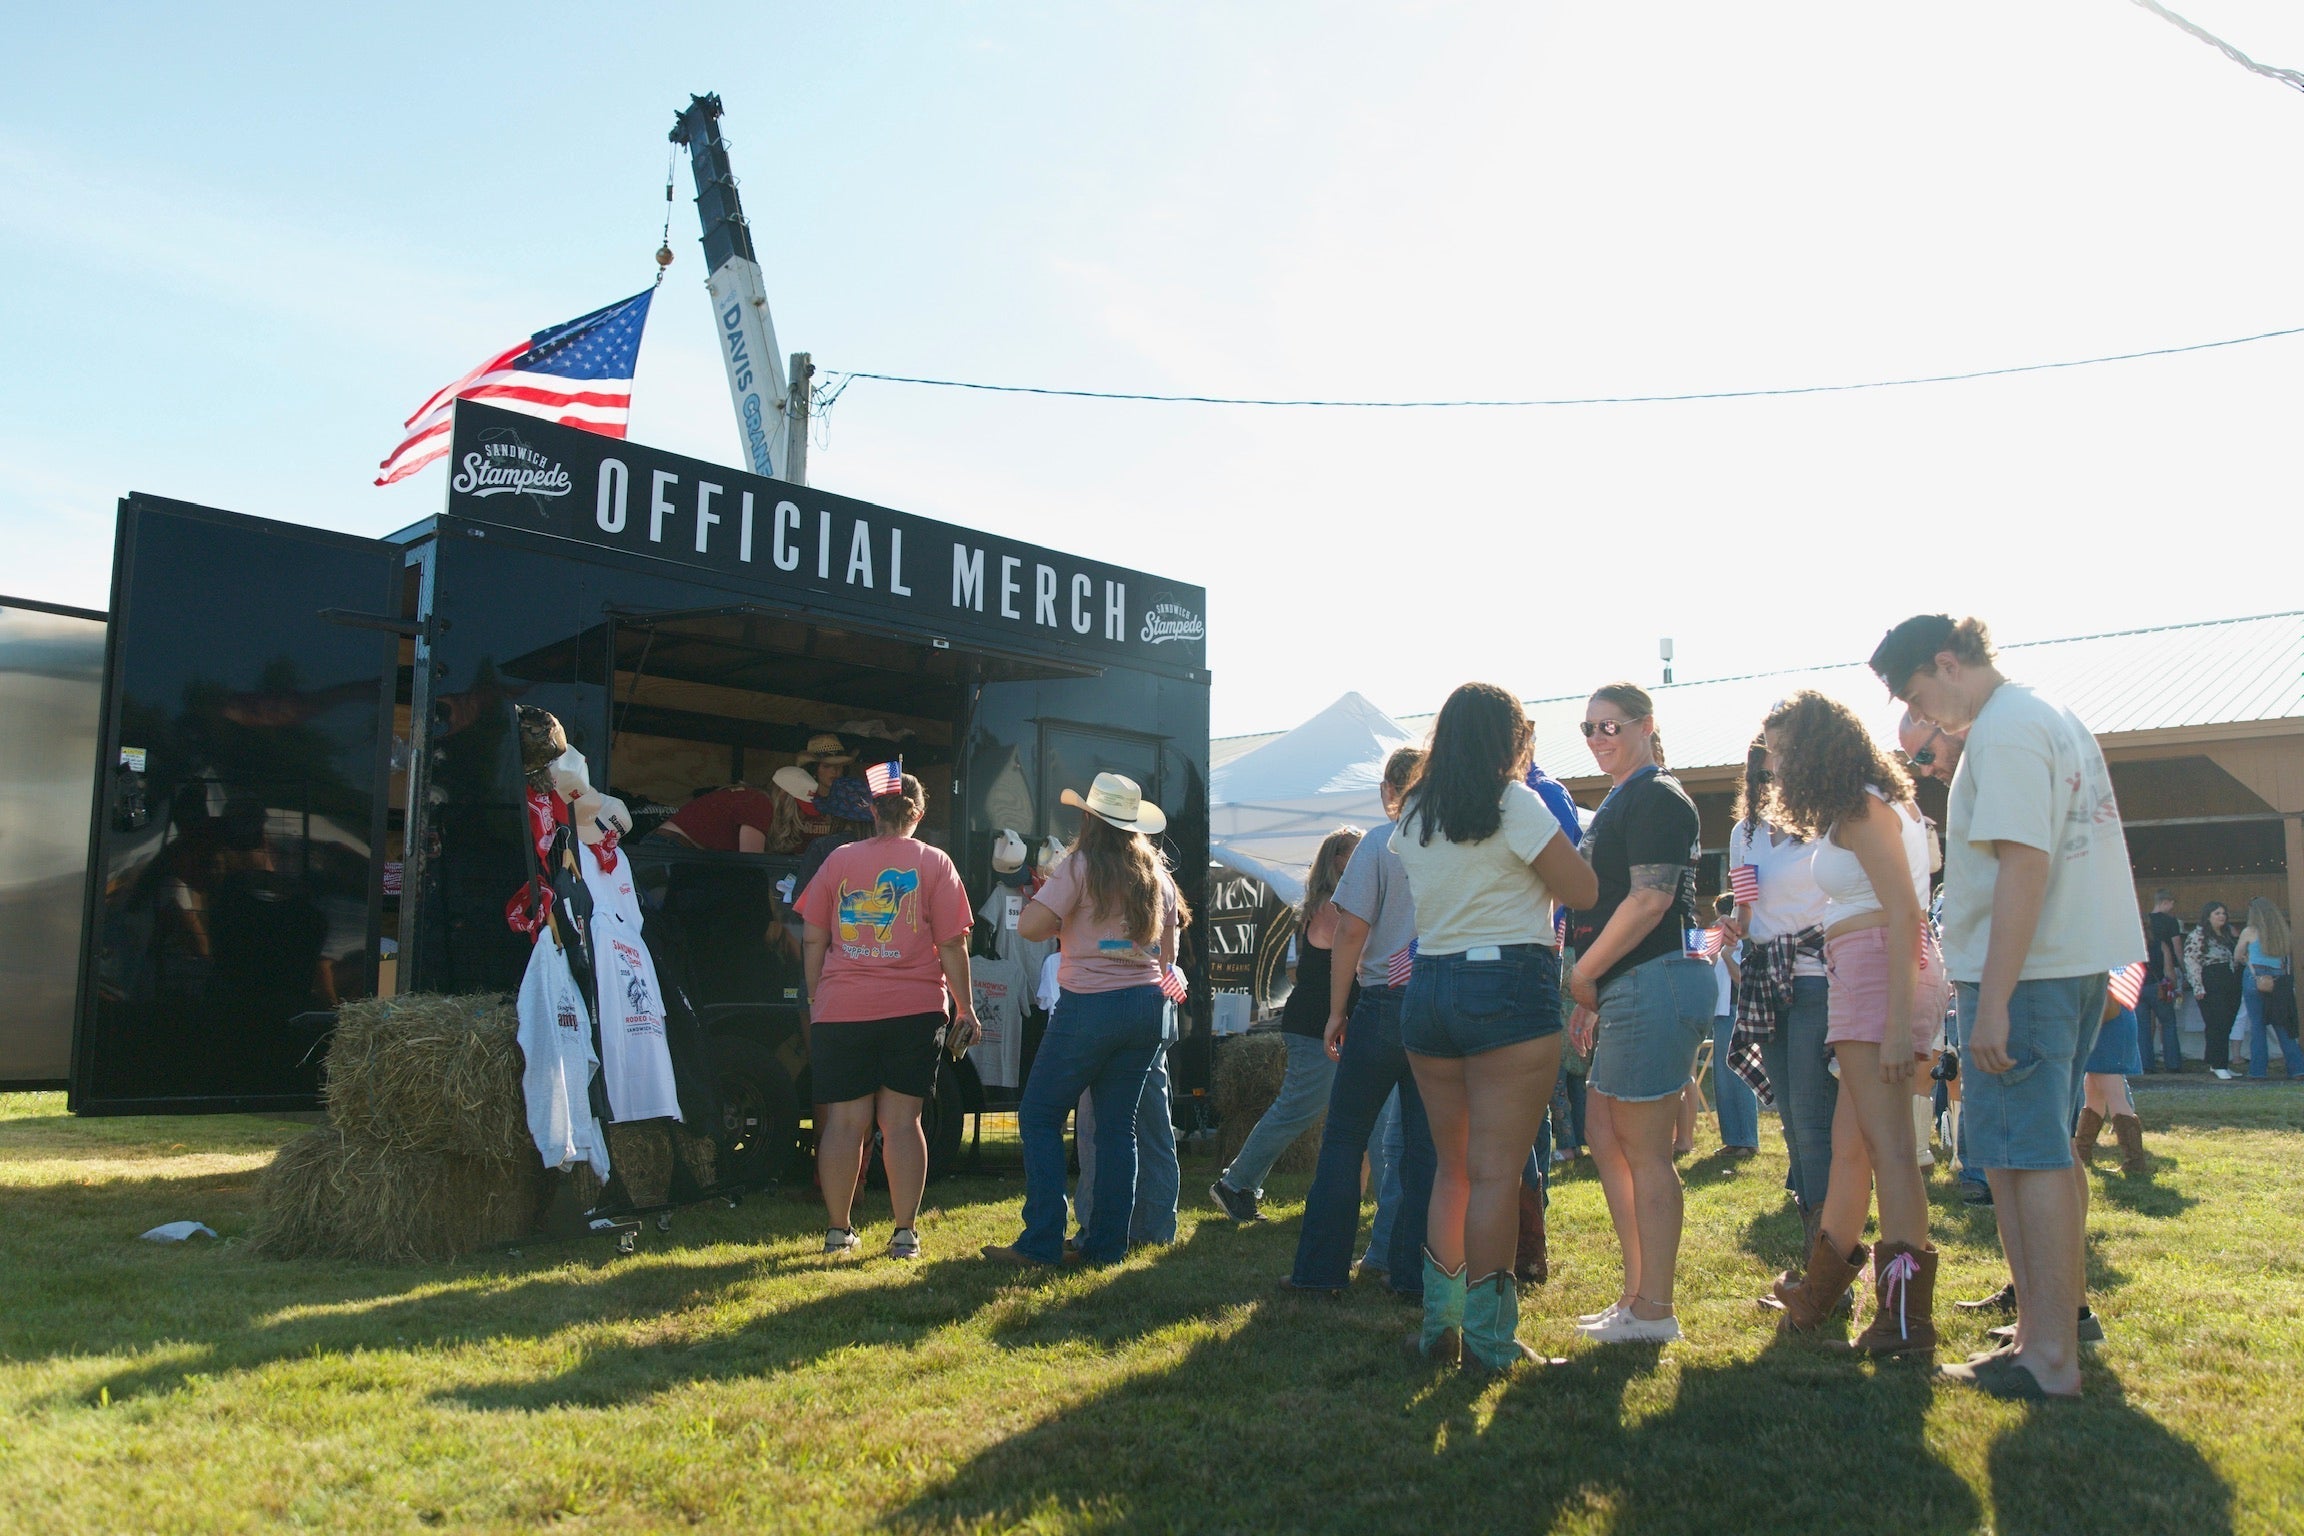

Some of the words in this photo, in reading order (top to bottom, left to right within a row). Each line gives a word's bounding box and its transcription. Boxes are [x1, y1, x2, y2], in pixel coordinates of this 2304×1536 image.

[723, 302, 753, 392] DAVIS
[485, 443, 549, 468] SANDWICH
[453, 452, 572, 497] Stampede
[596, 457, 912, 597] OFFICIAL
[952, 543, 1125, 642] MERCH
[1141, 611, 1205, 644] Stampede
[1156, 603, 1191, 620] SANDWICH
[625, 1015, 647, 1023] RODEO
